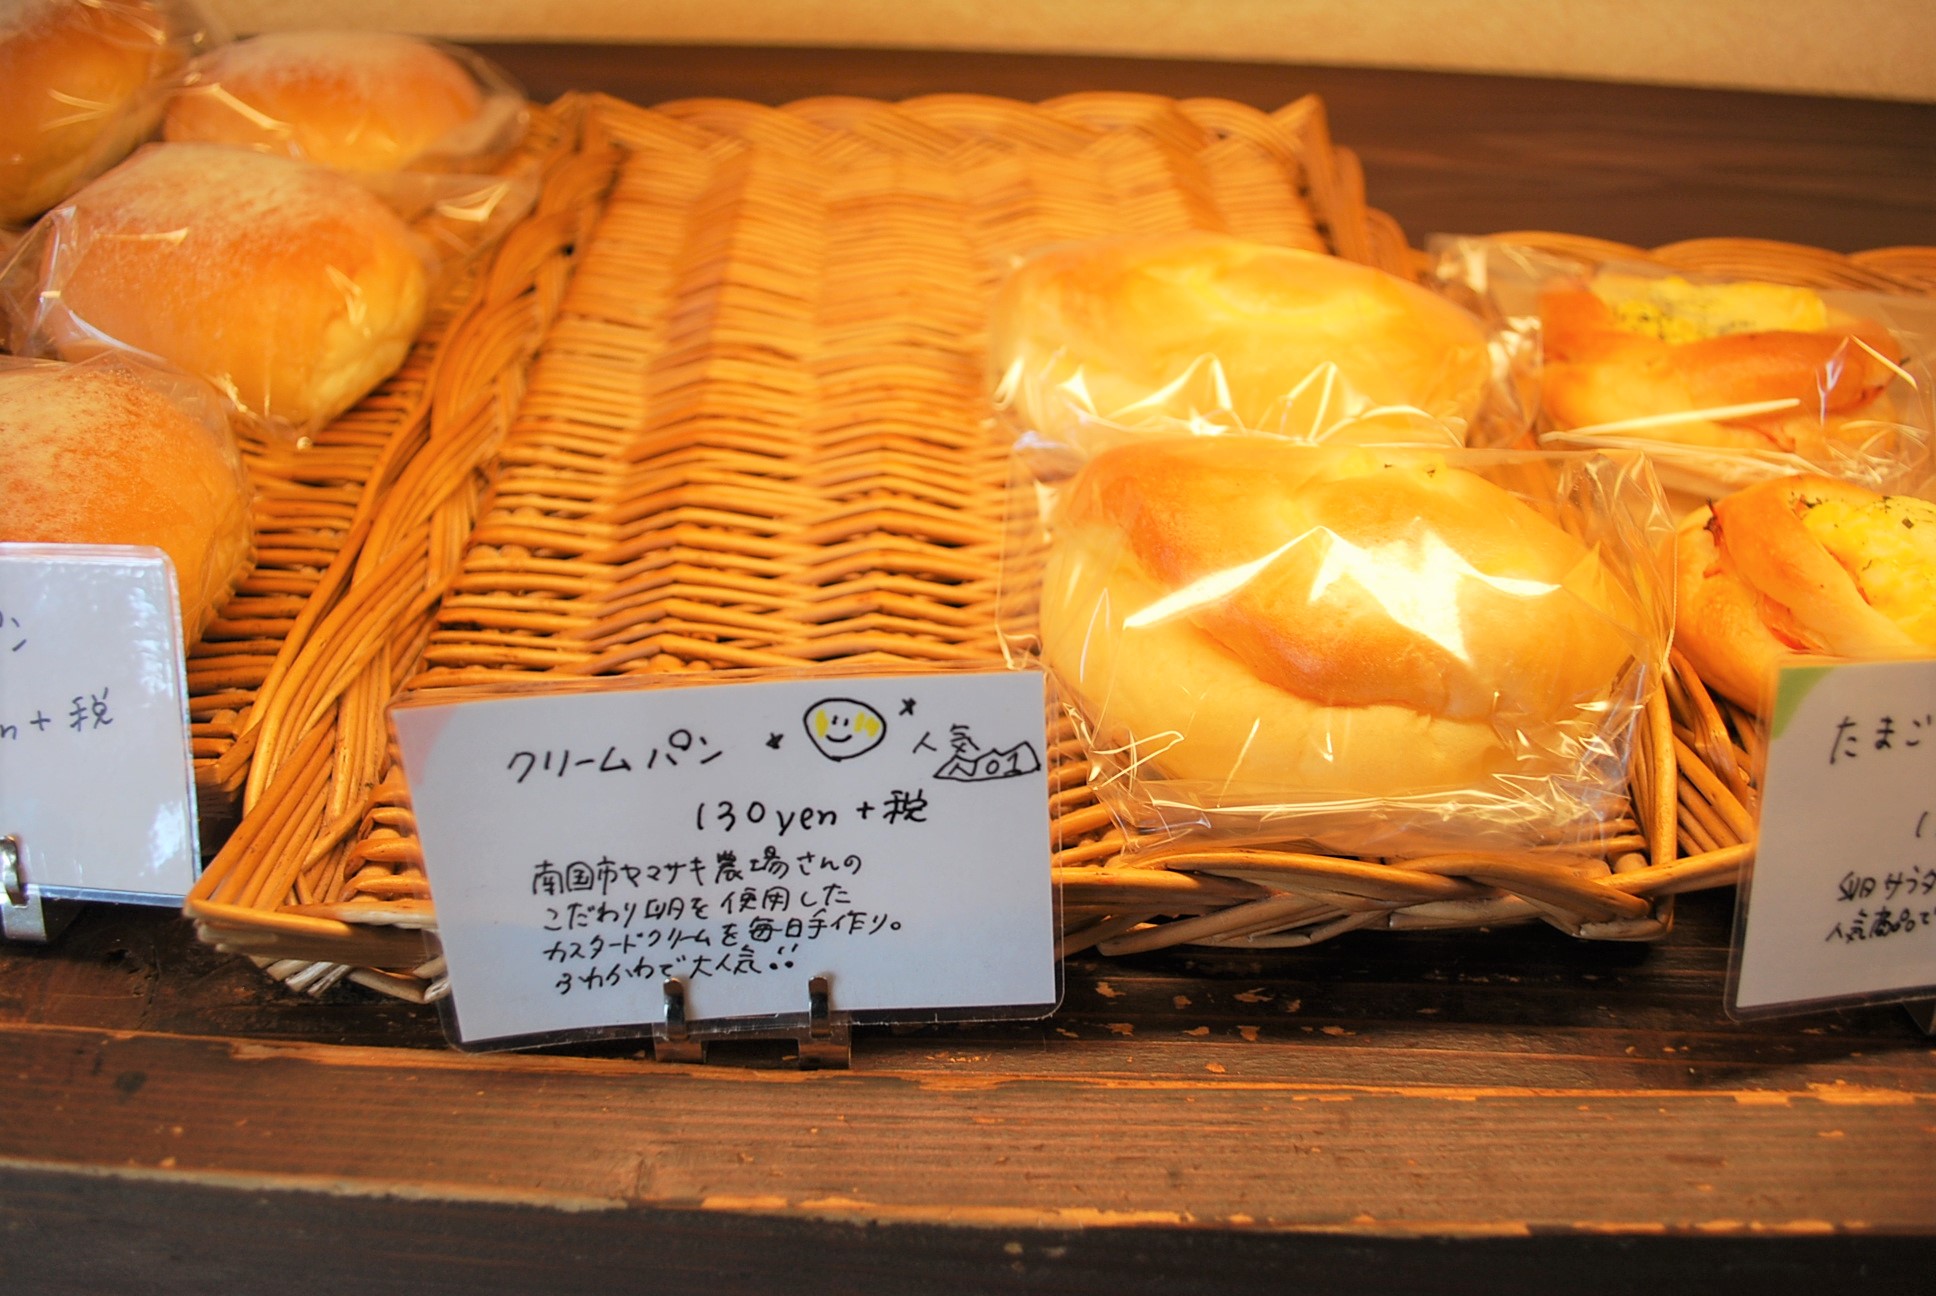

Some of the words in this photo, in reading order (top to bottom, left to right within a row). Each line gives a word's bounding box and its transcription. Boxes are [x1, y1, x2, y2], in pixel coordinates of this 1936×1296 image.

[507, 728, 723, 784] クリームパン
[543, 883, 851, 931] こだわり卵を使用した
